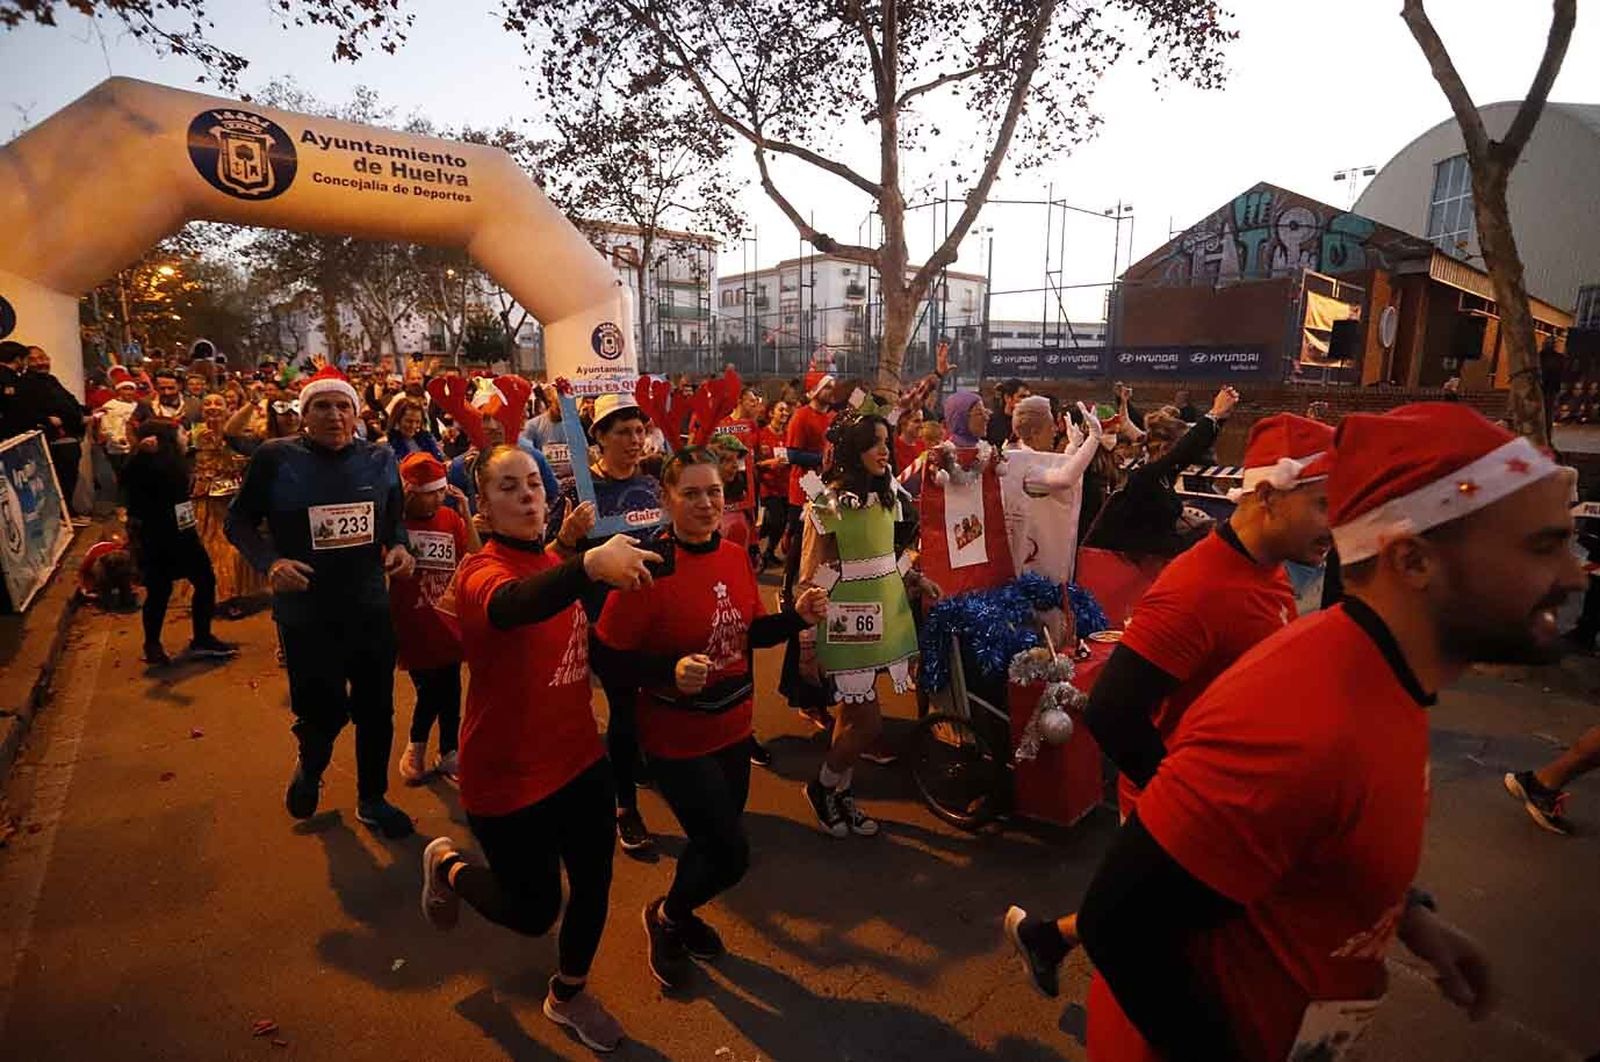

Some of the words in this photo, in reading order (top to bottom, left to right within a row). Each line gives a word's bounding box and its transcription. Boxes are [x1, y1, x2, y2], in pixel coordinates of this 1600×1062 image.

[301, 129, 468, 168] Ayuntamiento
[353, 157, 382, 175] de
[391, 161, 469, 187] Huelva
[392, 184, 410, 195] de
[413, 186, 472, 203] Deportes
[1004, 354, 1038, 363] HYUNDAI
[1061, 354, 1099, 363] HYUNDAI
[1135, 353, 1179, 362] HYUNDAI
[1209, 353, 1260, 362] HYUNDAI
[338, 516, 369, 535] 233
[428, 543, 453, 559] 235
[856, 615, 874, 631] 66
